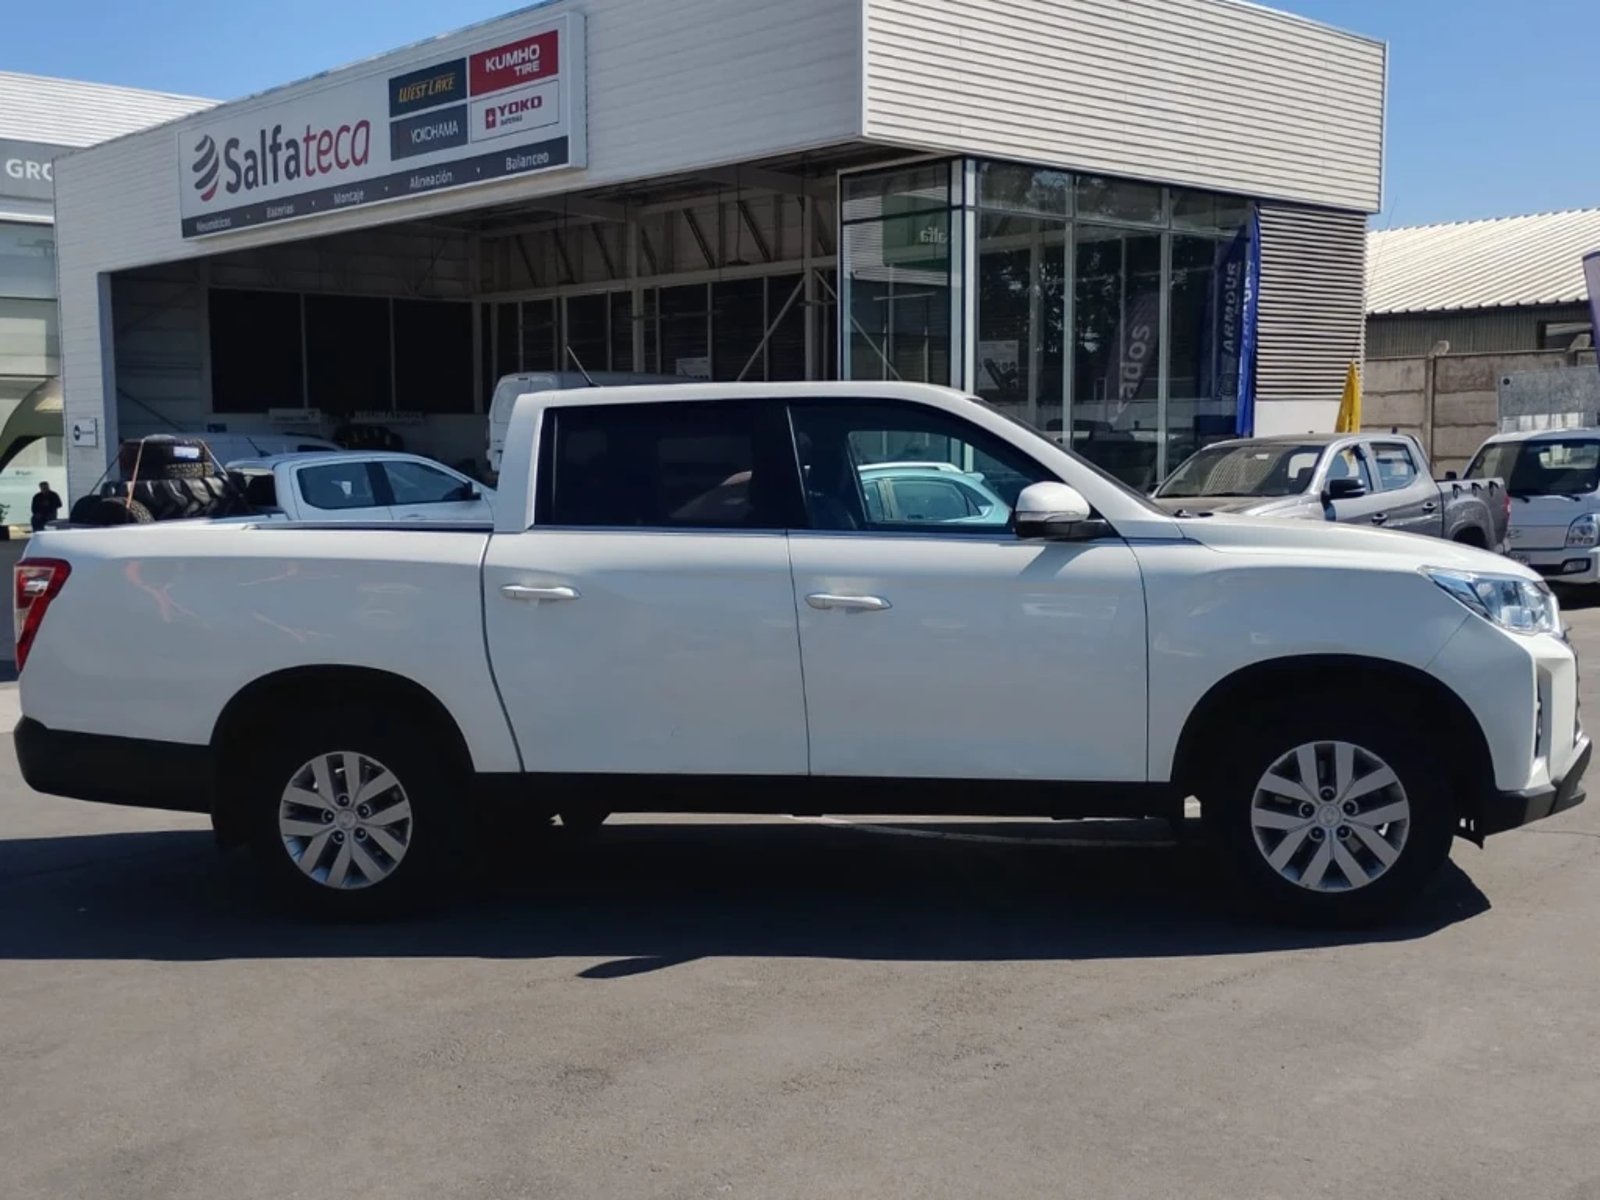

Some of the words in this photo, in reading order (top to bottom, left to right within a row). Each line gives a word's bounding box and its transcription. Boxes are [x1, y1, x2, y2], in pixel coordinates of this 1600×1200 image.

[485, 44, 540, 73] KUMHO
[514, 60, 540, 77] TIRE
[497, 95, 542, 117] YOKO
[410, 120, 459, 145] YOKOHAMA
[224, 119, 371, 194] Salfateca
[409, 169, 453, 190] Alineación
[505, 151, 549, 170] Balanceo
[1223, 261, 1238, 353] ARMOUR
